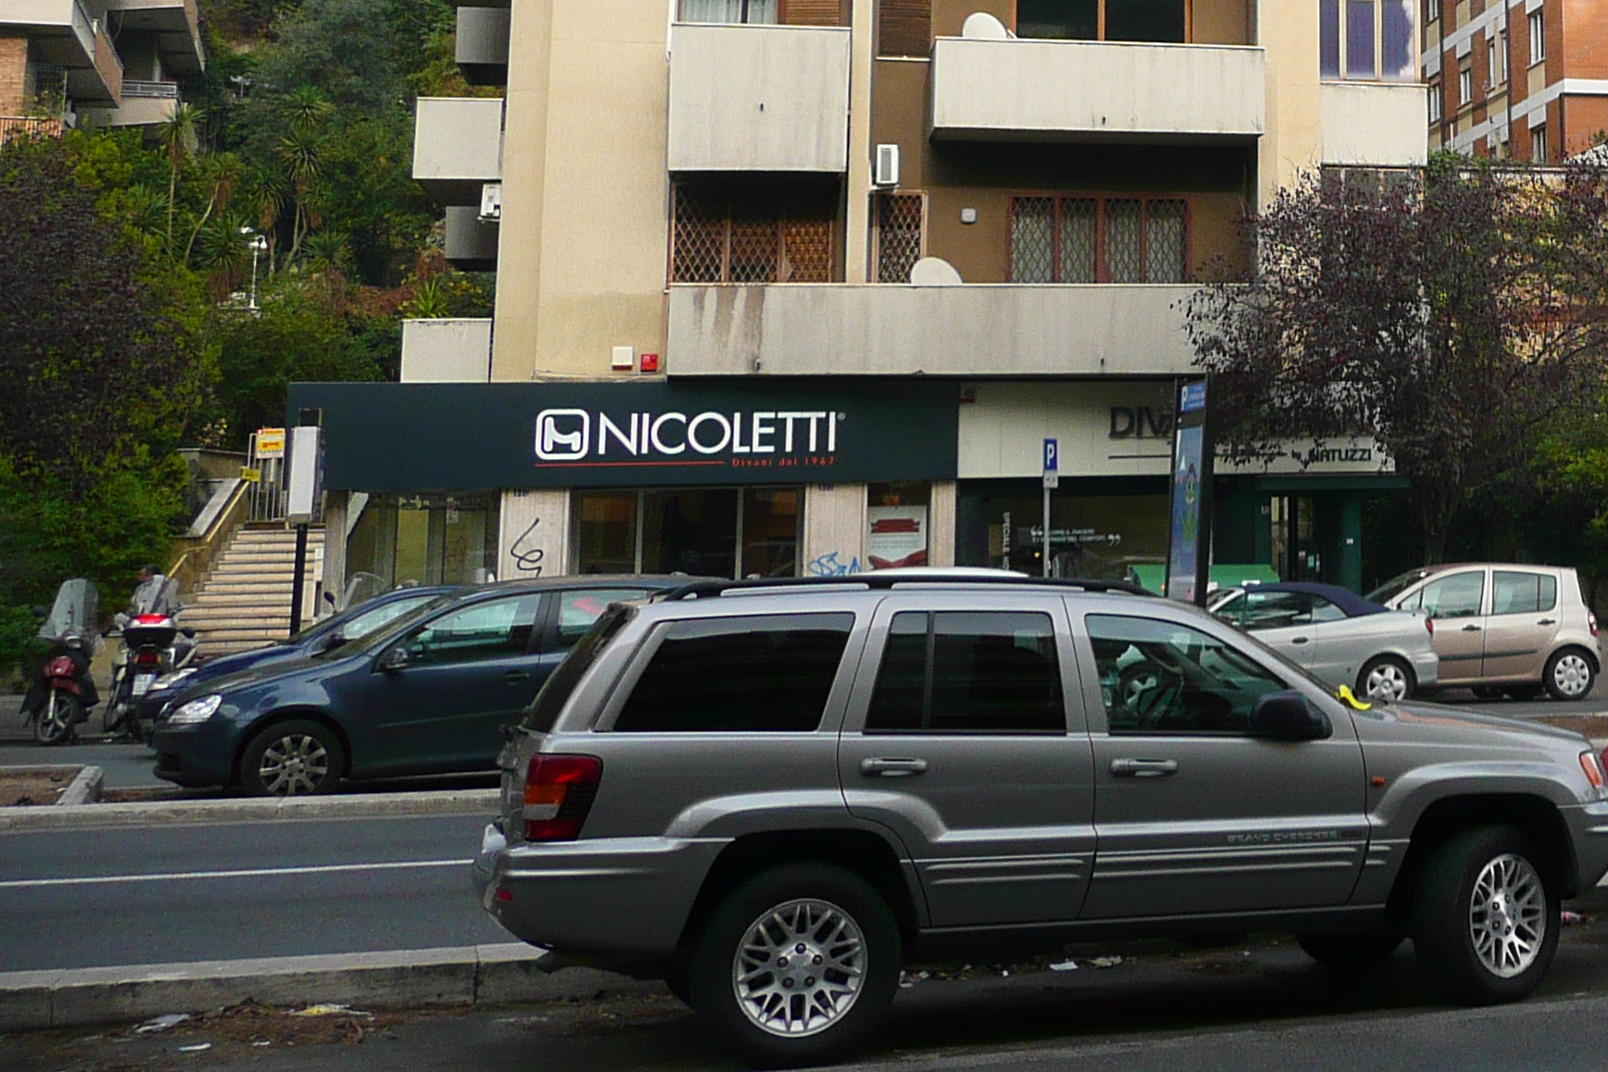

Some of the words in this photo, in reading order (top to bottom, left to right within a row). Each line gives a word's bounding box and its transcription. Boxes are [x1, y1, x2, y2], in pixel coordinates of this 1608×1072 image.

[598, 411, 836, 456] NICOLETTI
[732, 458, 773, 467] Divani
[779, 457, 798, 466] dal
[805, 456, 835, 466] 1967
[1046, 443, 1055, 466] P
[1309, 448, 1372, 463] NATUZZI
[1227, 834, 1271, 843] GRAND
[1273, 830, 1338, 842] CHEROKEE
